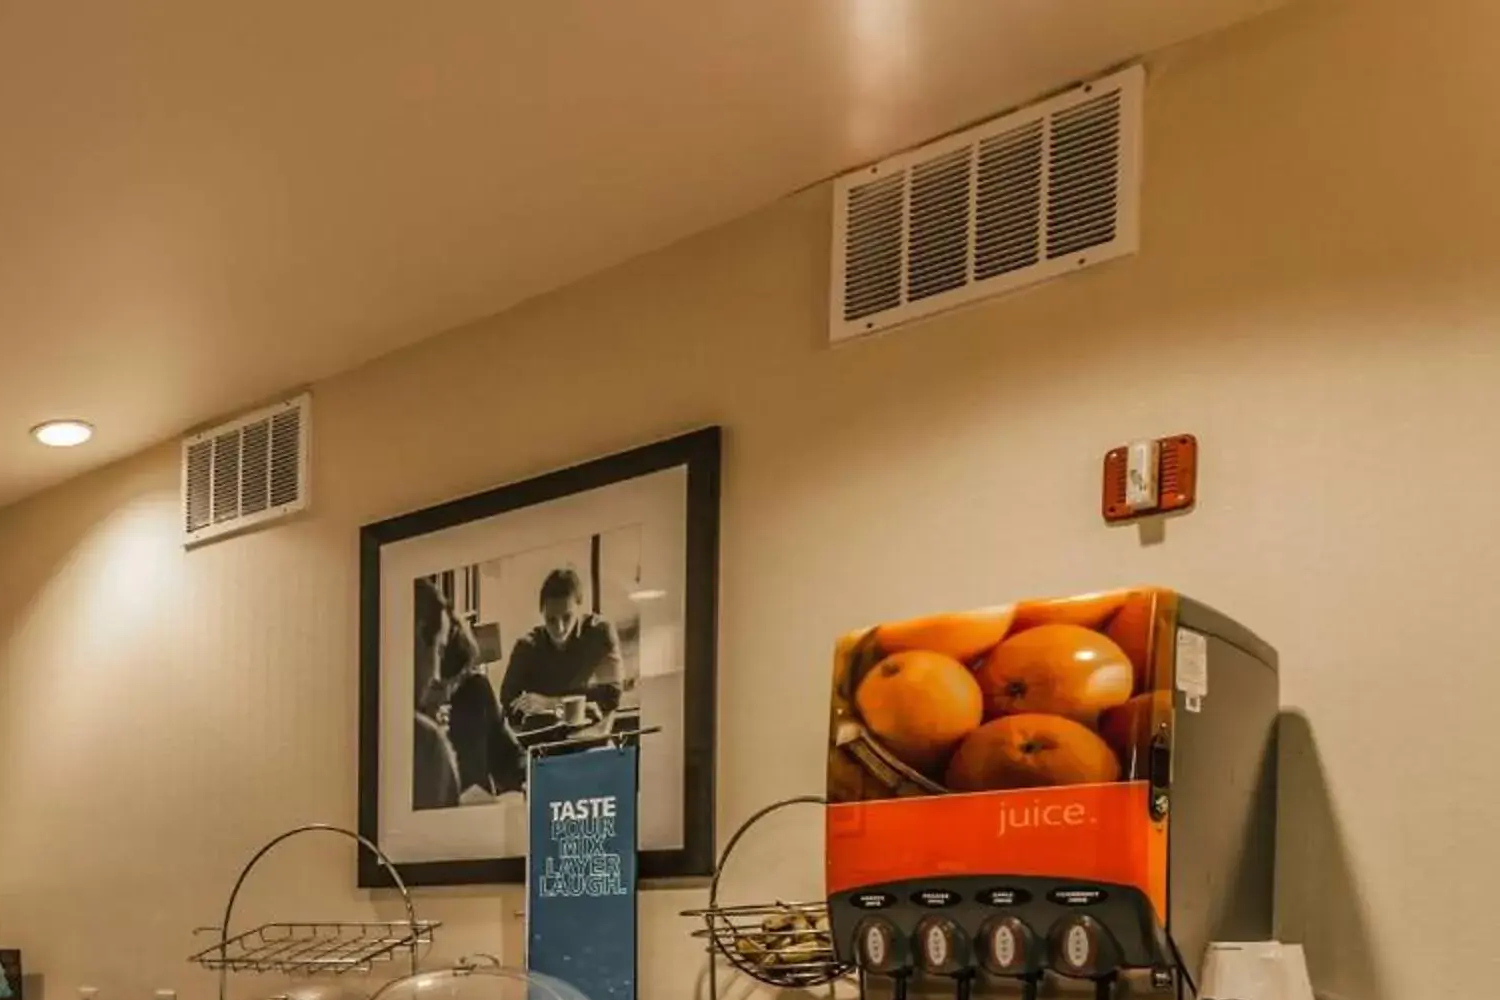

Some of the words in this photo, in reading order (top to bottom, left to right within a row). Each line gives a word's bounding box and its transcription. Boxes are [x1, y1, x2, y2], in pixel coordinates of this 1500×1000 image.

[549, 796, 616, 820] TASTE
[551, 818, 616, 840] POUR
[559, 836, 606, 858] MIX
[546, 853, 620, 877] LAYER
[539, 875, 627, 897] LAUGH.
